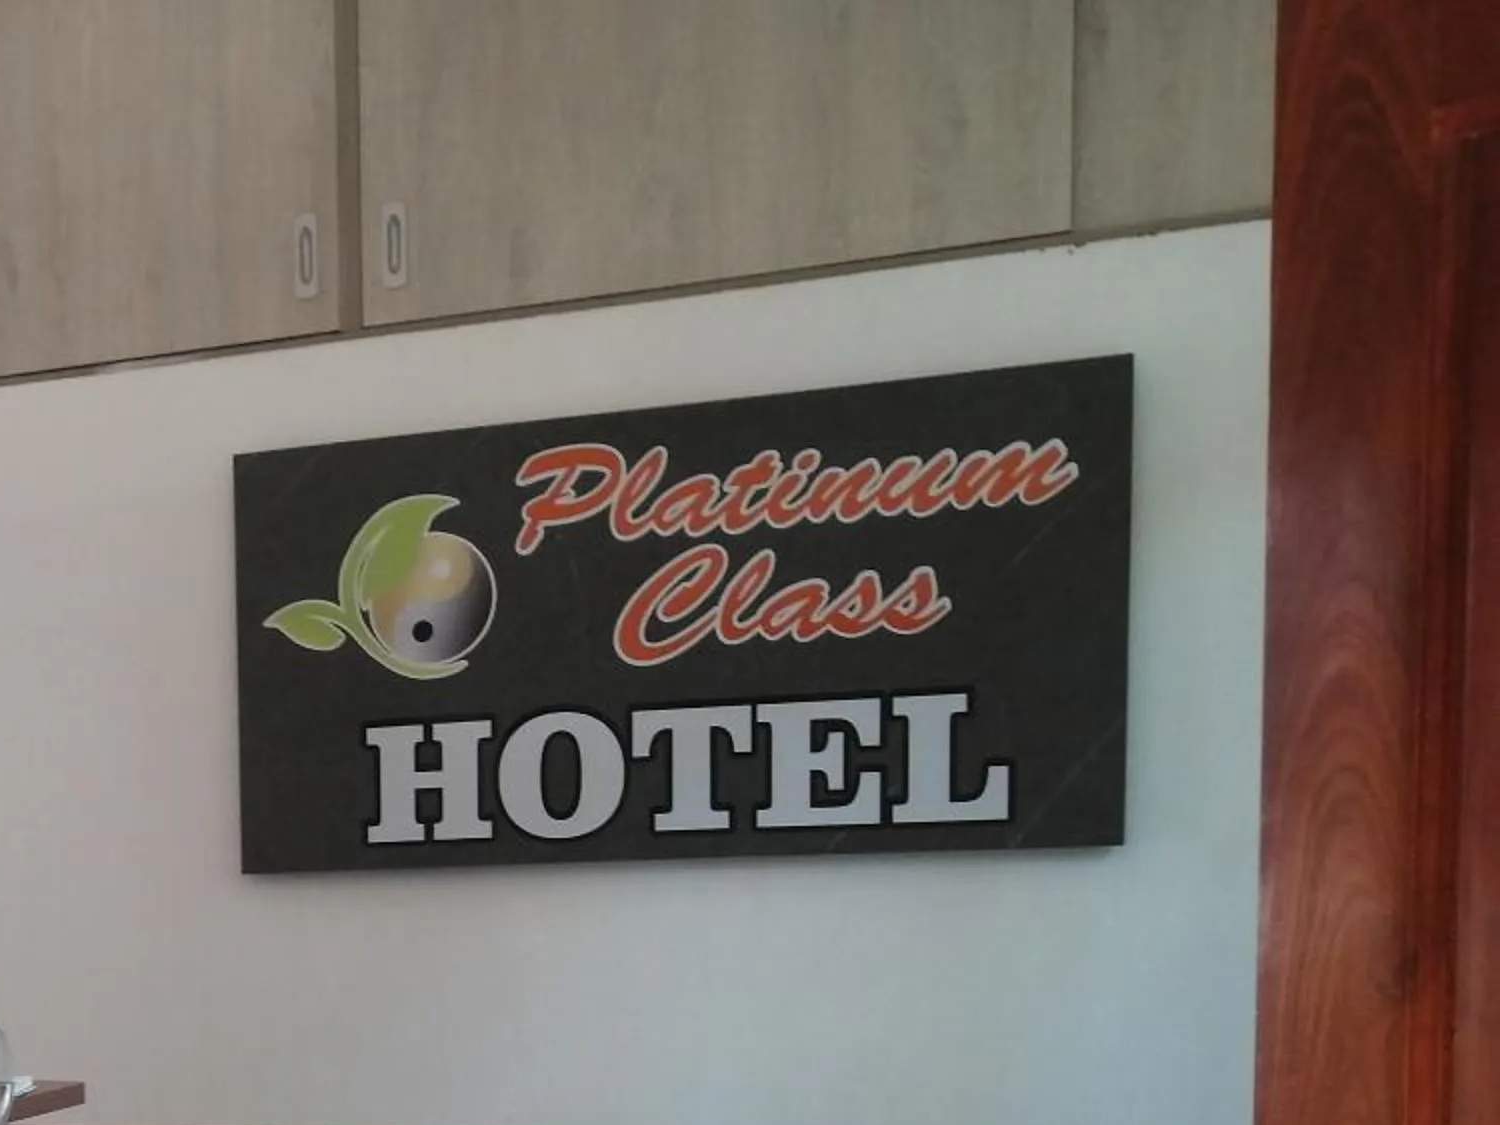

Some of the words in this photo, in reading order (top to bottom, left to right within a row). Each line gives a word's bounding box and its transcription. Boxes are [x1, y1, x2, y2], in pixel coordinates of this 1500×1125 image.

[514, 437, 1080, 556] Platinum
[612, 543, 952, 667] Class
[363, 691, 1012, 845] HOTEL
